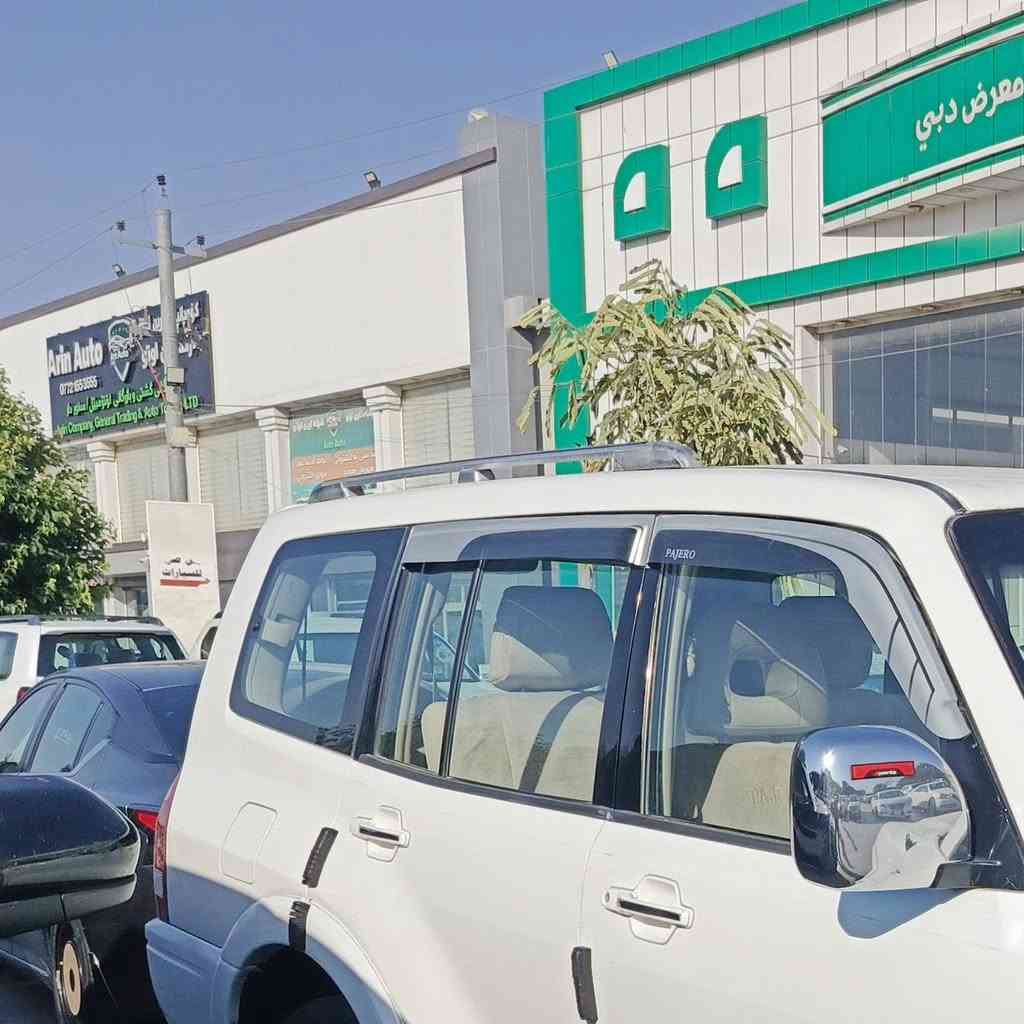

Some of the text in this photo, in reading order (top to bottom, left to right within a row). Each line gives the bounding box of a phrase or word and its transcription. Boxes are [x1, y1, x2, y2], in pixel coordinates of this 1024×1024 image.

[915, 76, 1024, 152] معرض دبي
[73, 337, 104, 372] Auto
[664, 547, 696, 561] PAJERO
